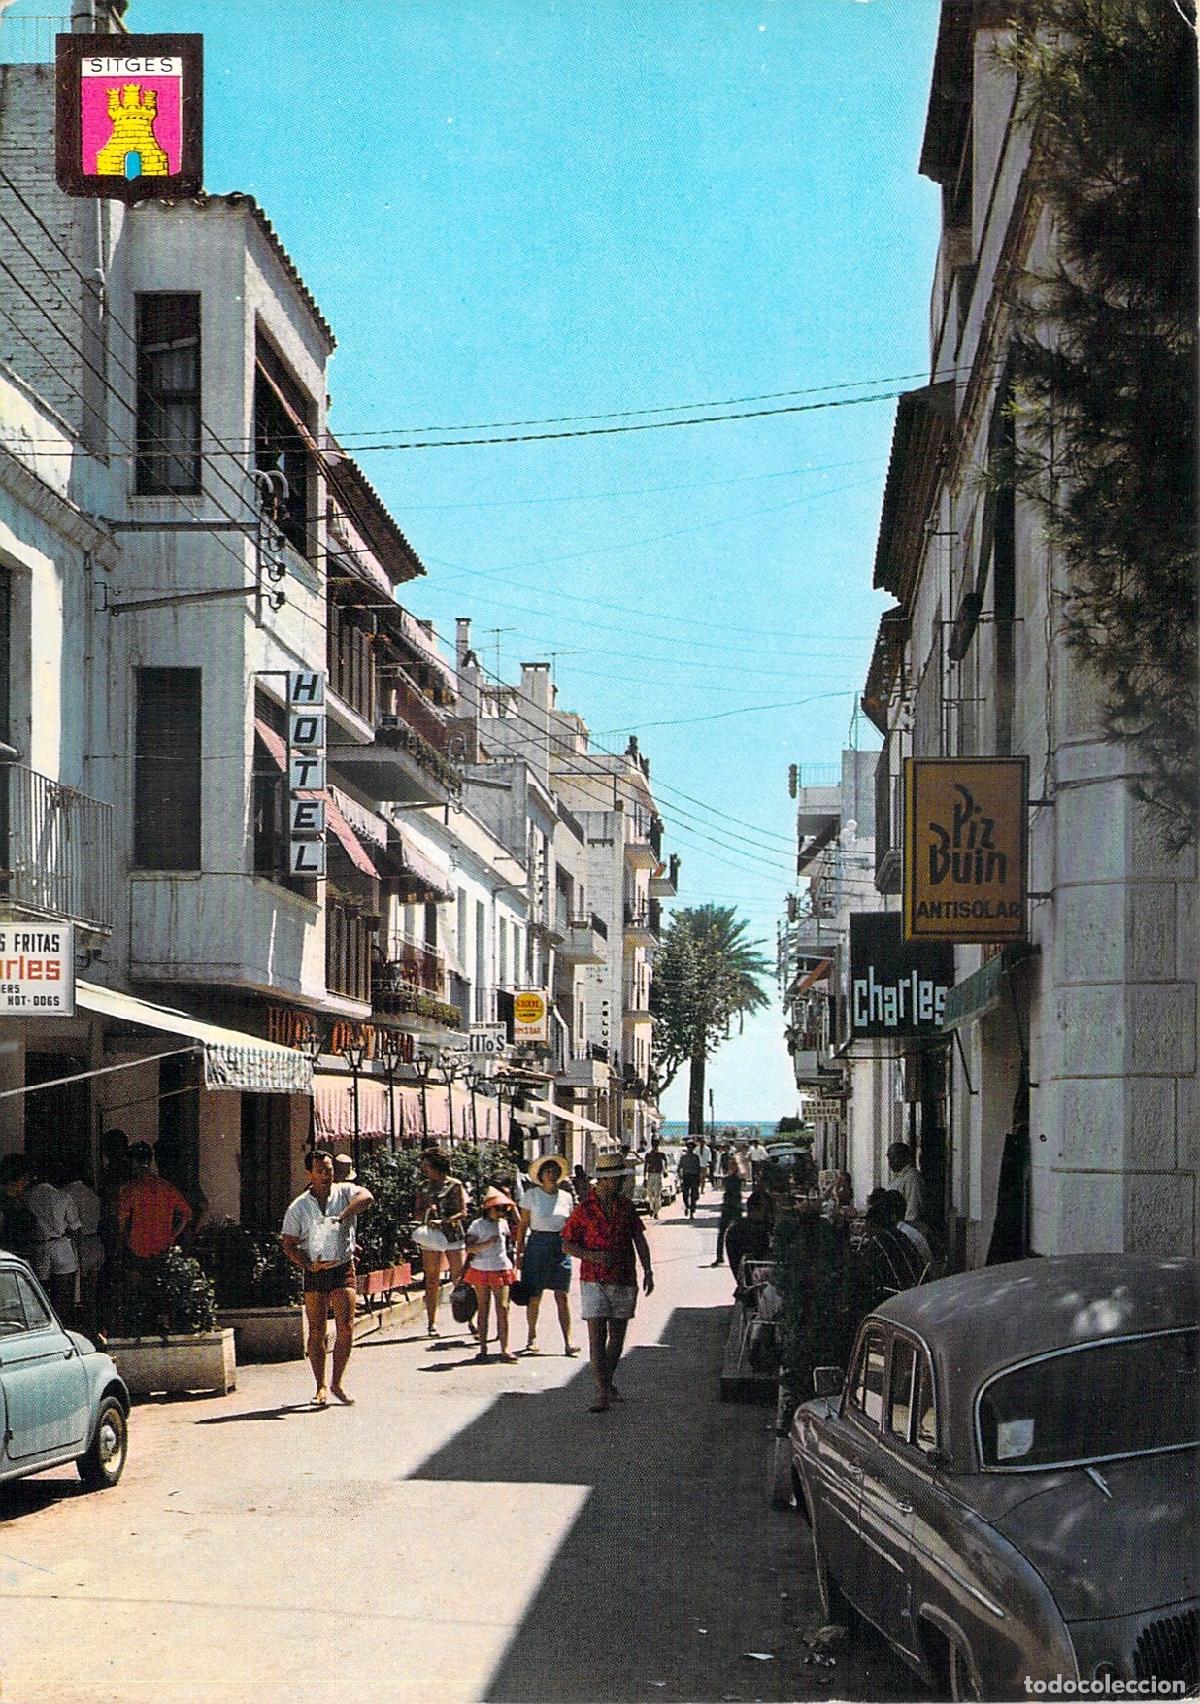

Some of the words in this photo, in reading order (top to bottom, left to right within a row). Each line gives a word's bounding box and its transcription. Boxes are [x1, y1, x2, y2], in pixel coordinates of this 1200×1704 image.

[293, 673, 318, 871] HOTEL
[916, 900, 1019, 919] ANTISOLAR
[14, 933, 60, 953] FRITAS
[0, 955, 61, 980] rles
[8, 995, 60, 1007] HOT-DOGS
[853, 965, 946, 1027] charles
